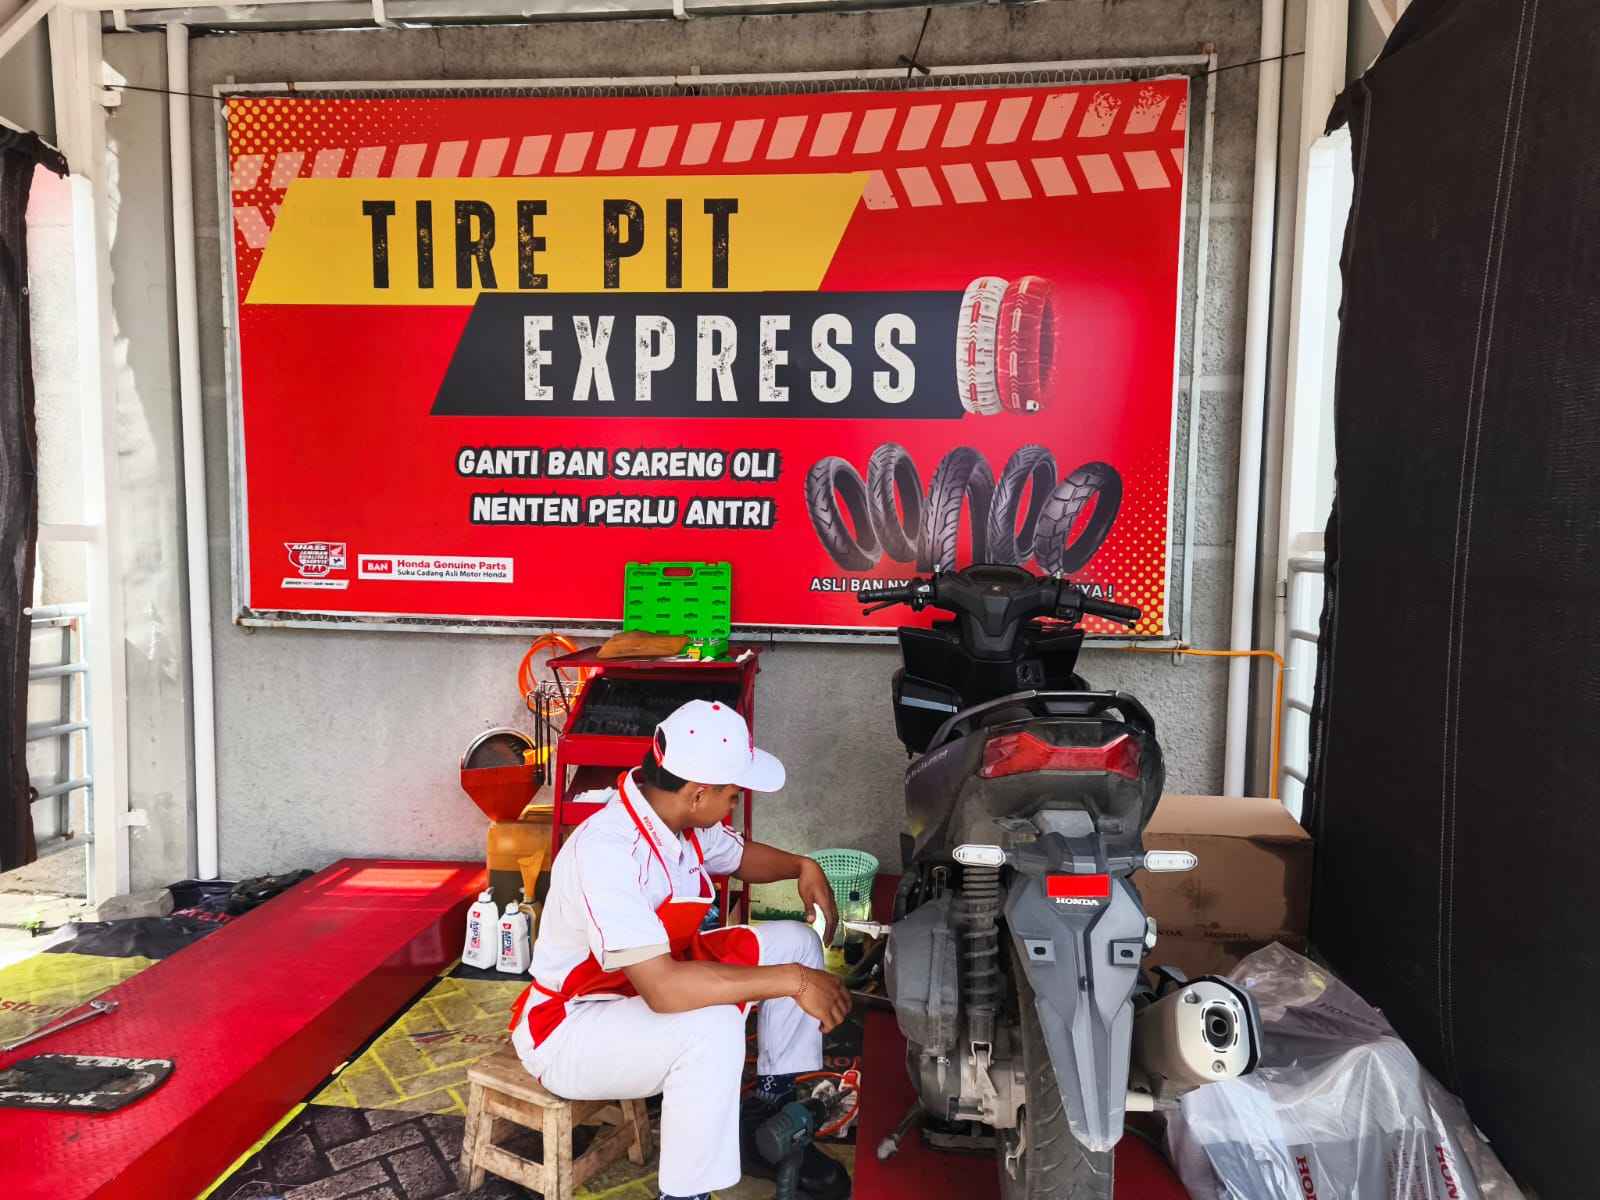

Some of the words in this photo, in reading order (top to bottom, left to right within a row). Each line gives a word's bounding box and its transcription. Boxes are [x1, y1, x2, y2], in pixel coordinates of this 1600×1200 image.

[362, 199, 548, 290] TIRE
[603, 198, 739, 289] PIT
[522, 312, 918, 404] EXPRESS
[457, 448, 539, 476] GANTI
[547, 449, 605, 477] BAN
[614, 450, 723, 478] SARENG
[733, 451, 777, 479] OLI
[472, 495, 579, 523] NENTEN
[588, 497, 676, 525] PERLU
[685, 499, 772, 527] ANTRI
[367, 562, 388, 571] BAN
[397, 559, 431, 569] Honda
[433, 561, 476, 570] Genuine
[478, 562, 507, 571] Parts
[397, 569, 415, 577] Suku
[416, 570, 444, 579] Cadang
[811, 578, 846, 591] ASLI
[850, 578, 883, 591] BAN
[1055, 896, 1100, 907] HONDA
